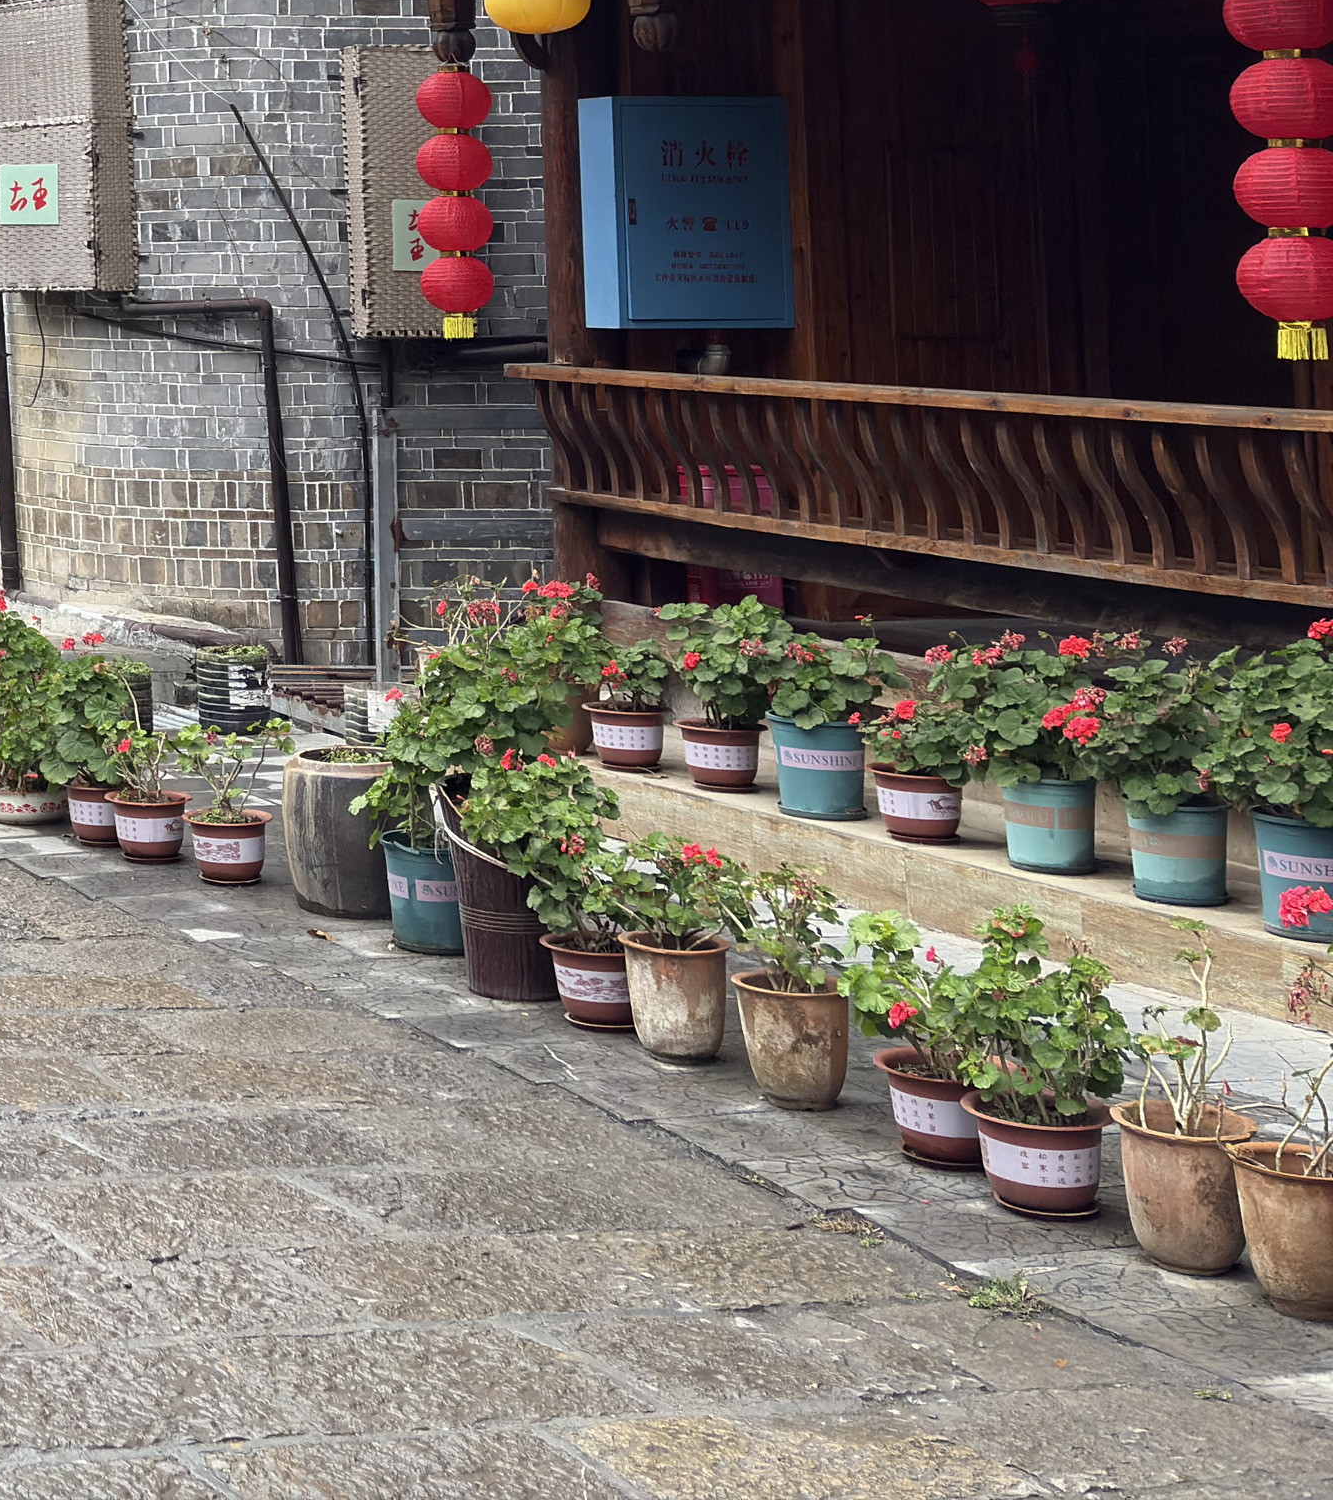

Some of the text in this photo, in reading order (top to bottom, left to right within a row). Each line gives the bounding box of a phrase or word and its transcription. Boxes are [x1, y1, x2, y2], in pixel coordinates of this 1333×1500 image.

[661, 140, 749, 168] 消火栓
[726, 219, 750, 232] 119
